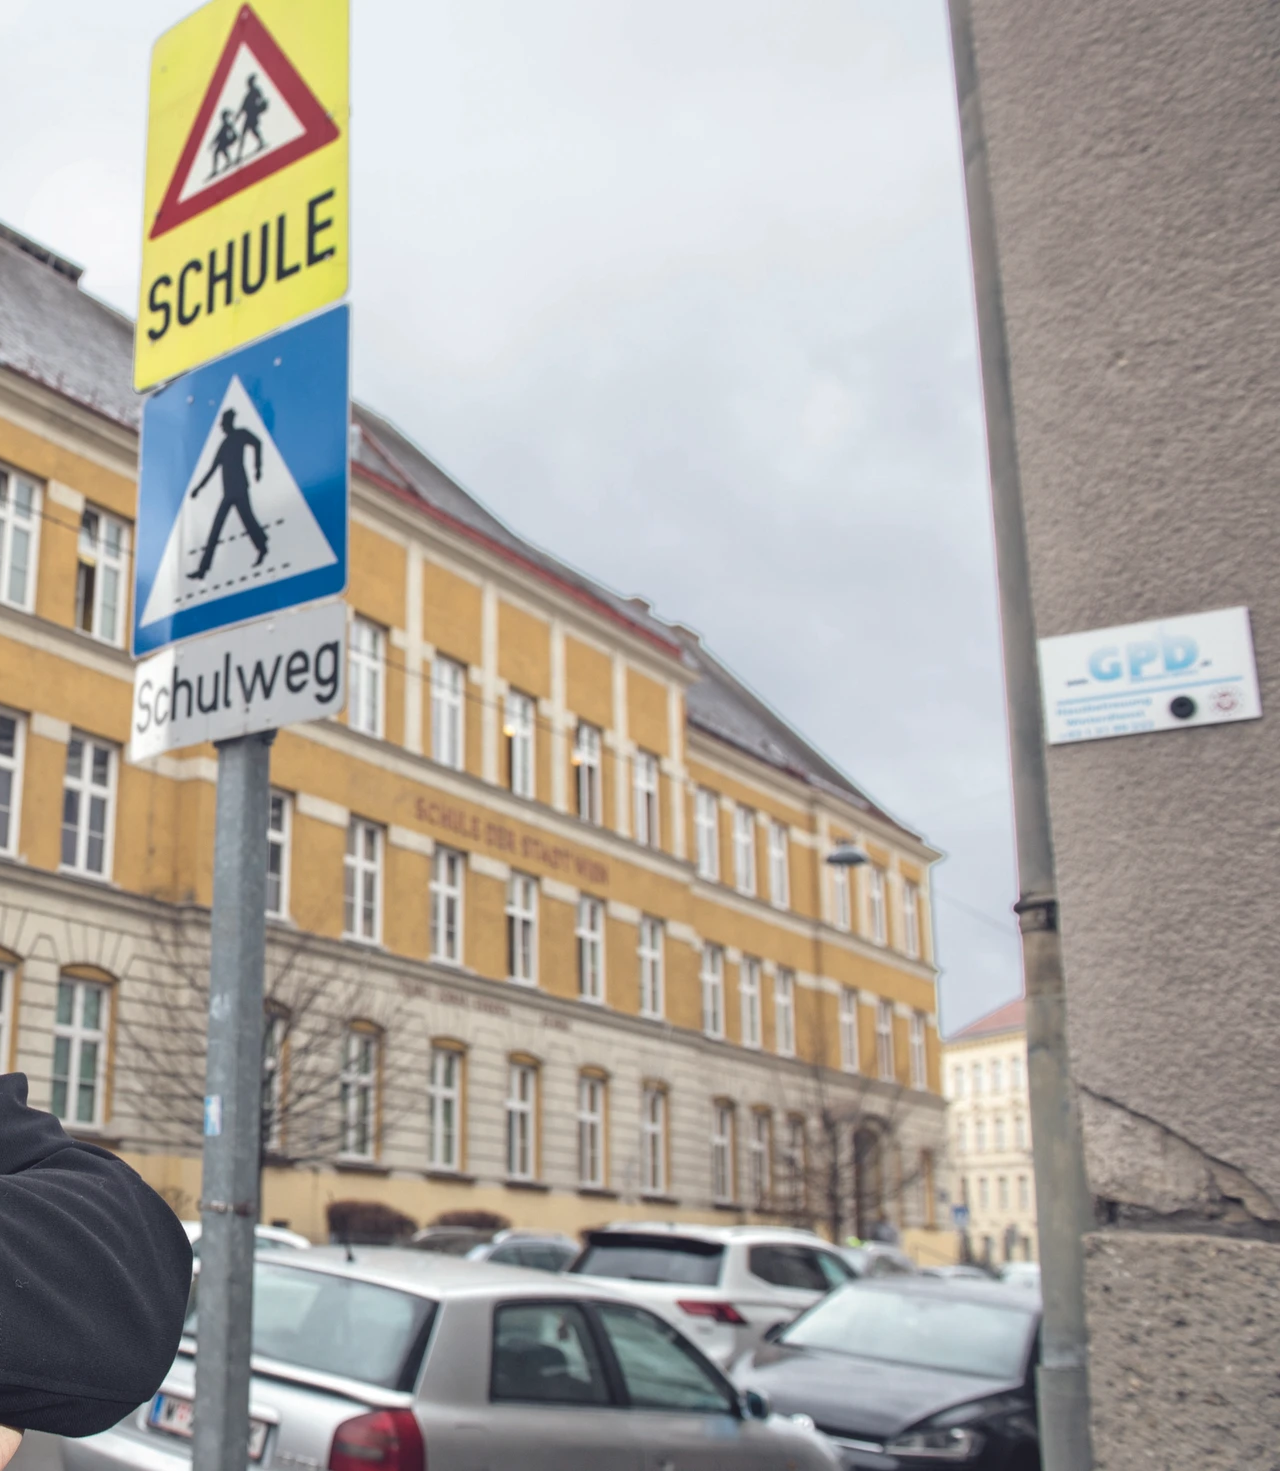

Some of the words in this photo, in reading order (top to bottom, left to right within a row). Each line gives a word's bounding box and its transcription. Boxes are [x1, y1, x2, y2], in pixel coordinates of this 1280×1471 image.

[147, 188, 336, 342] SCHULE
[136, 640, 340, 734] Schulweg
[415, 797, 481, 840] SCHULE
[485, 822, 516, 852] DER
[522, 834, 573, 873] STADT
